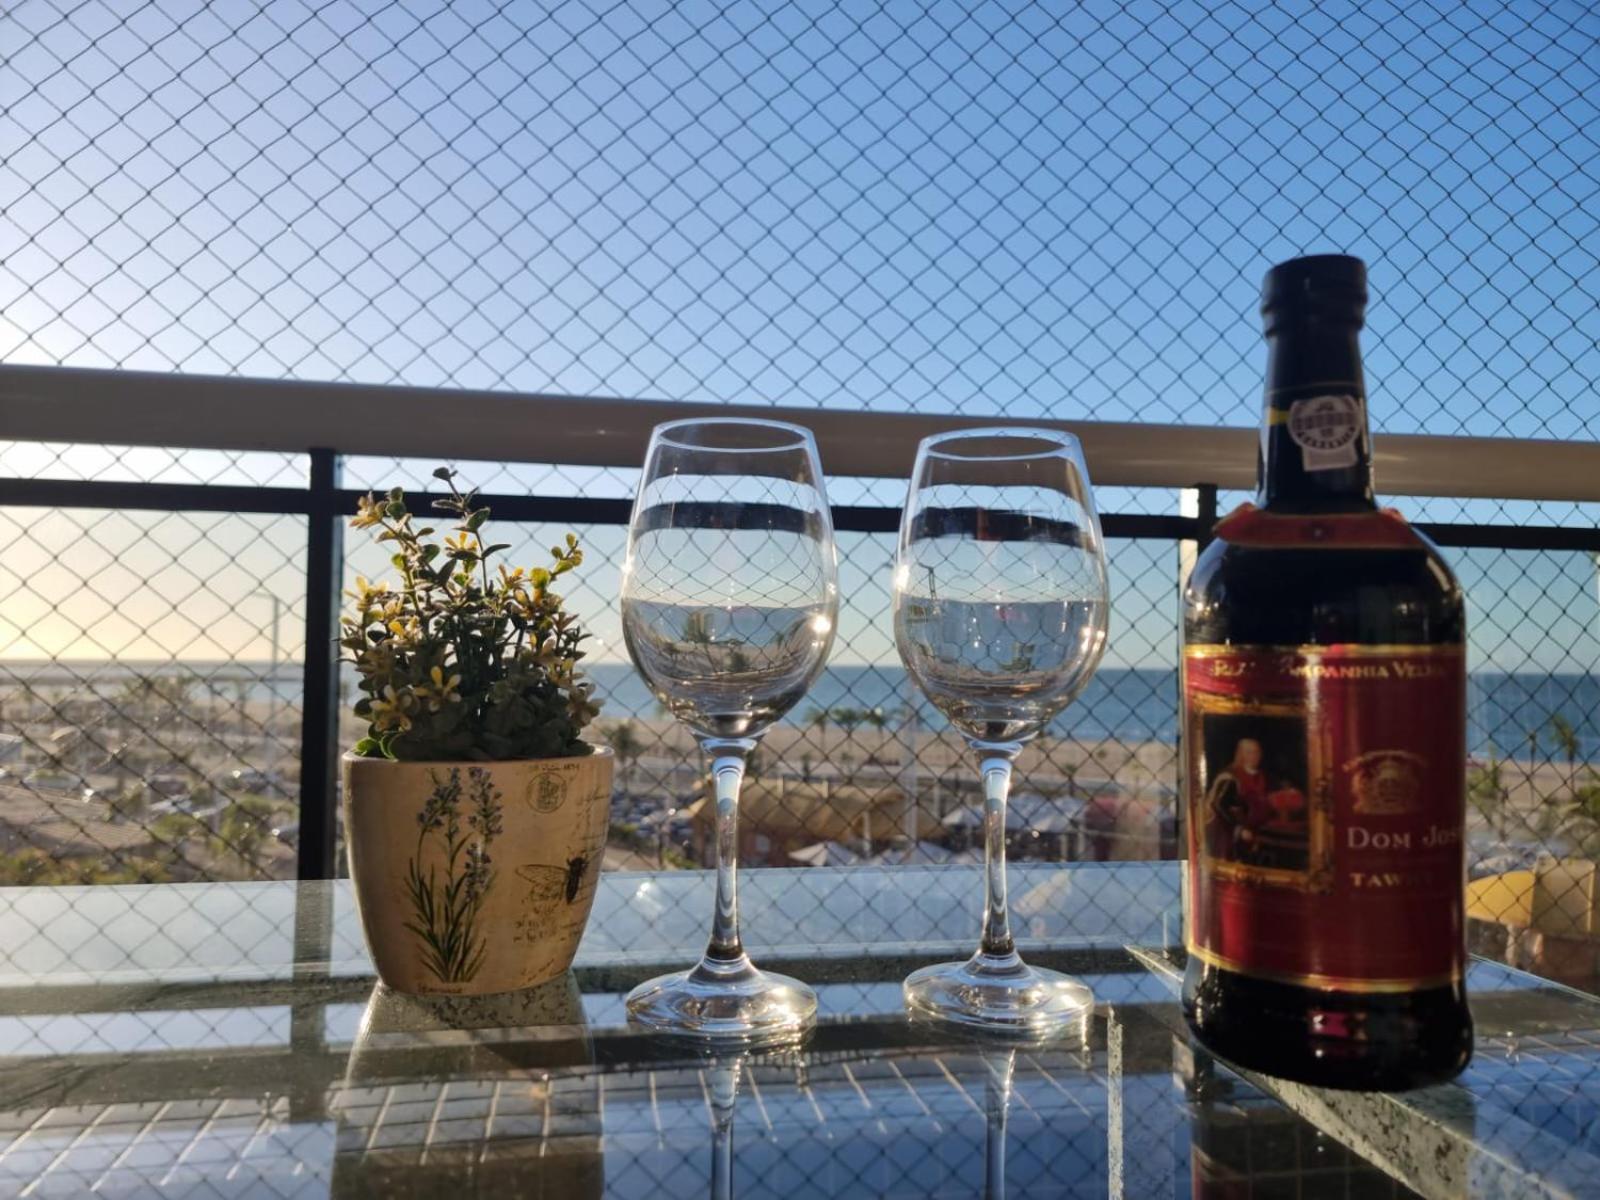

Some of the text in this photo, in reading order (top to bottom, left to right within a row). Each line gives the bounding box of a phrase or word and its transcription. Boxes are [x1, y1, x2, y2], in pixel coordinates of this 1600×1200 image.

[1347, 824, 1459, 849] DOM JOS
[1349, 872, 1424, 887] TAW
